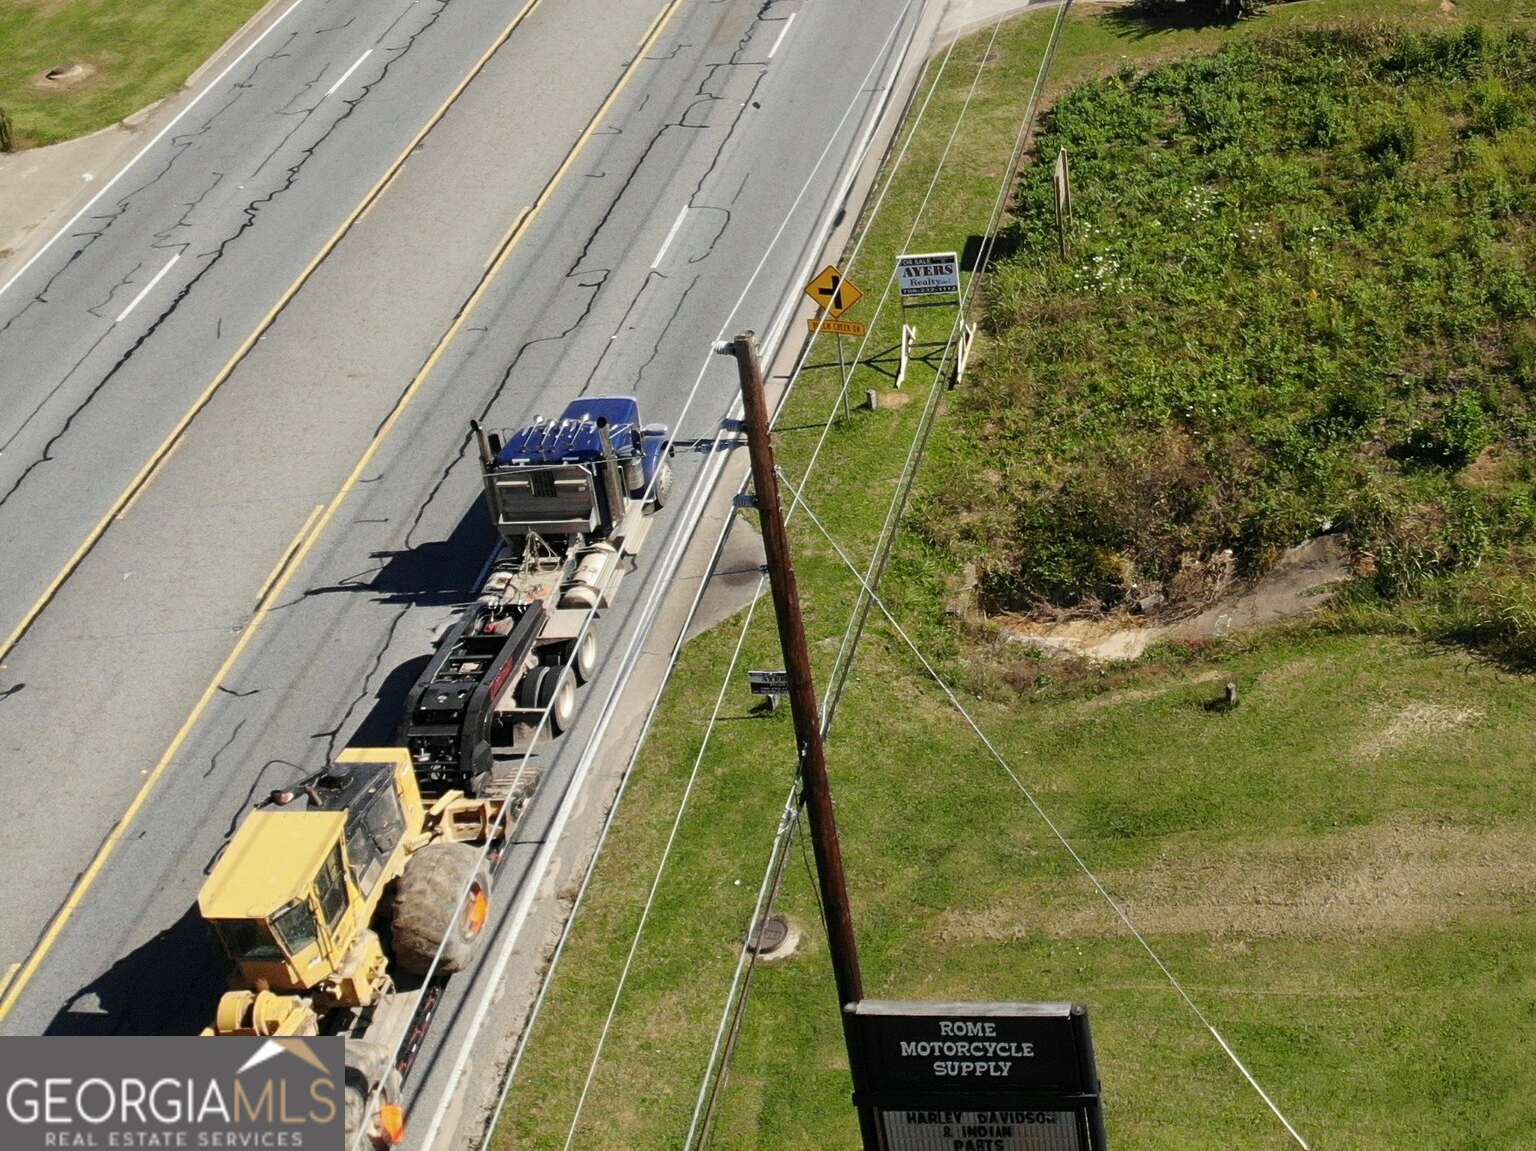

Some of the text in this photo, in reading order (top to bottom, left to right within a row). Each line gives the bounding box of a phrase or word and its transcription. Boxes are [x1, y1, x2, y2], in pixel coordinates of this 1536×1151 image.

[903, 265, 953, 278] AYERS
[910, 278, 940, 287] Realty
[812, 321, 831, 331] BCH
[939, 1020, 997, 1037] ROME
[900, 1041, 1035, 1057] MOTORCYCLE
[933, 1061, 1012, 1076] SUPPLY
[906, 1112, 962, 1124] HARLEY
[943, 1126, 1012, 1138] & INDIAN
[954, 1139, 1005, 1151] PARTS
